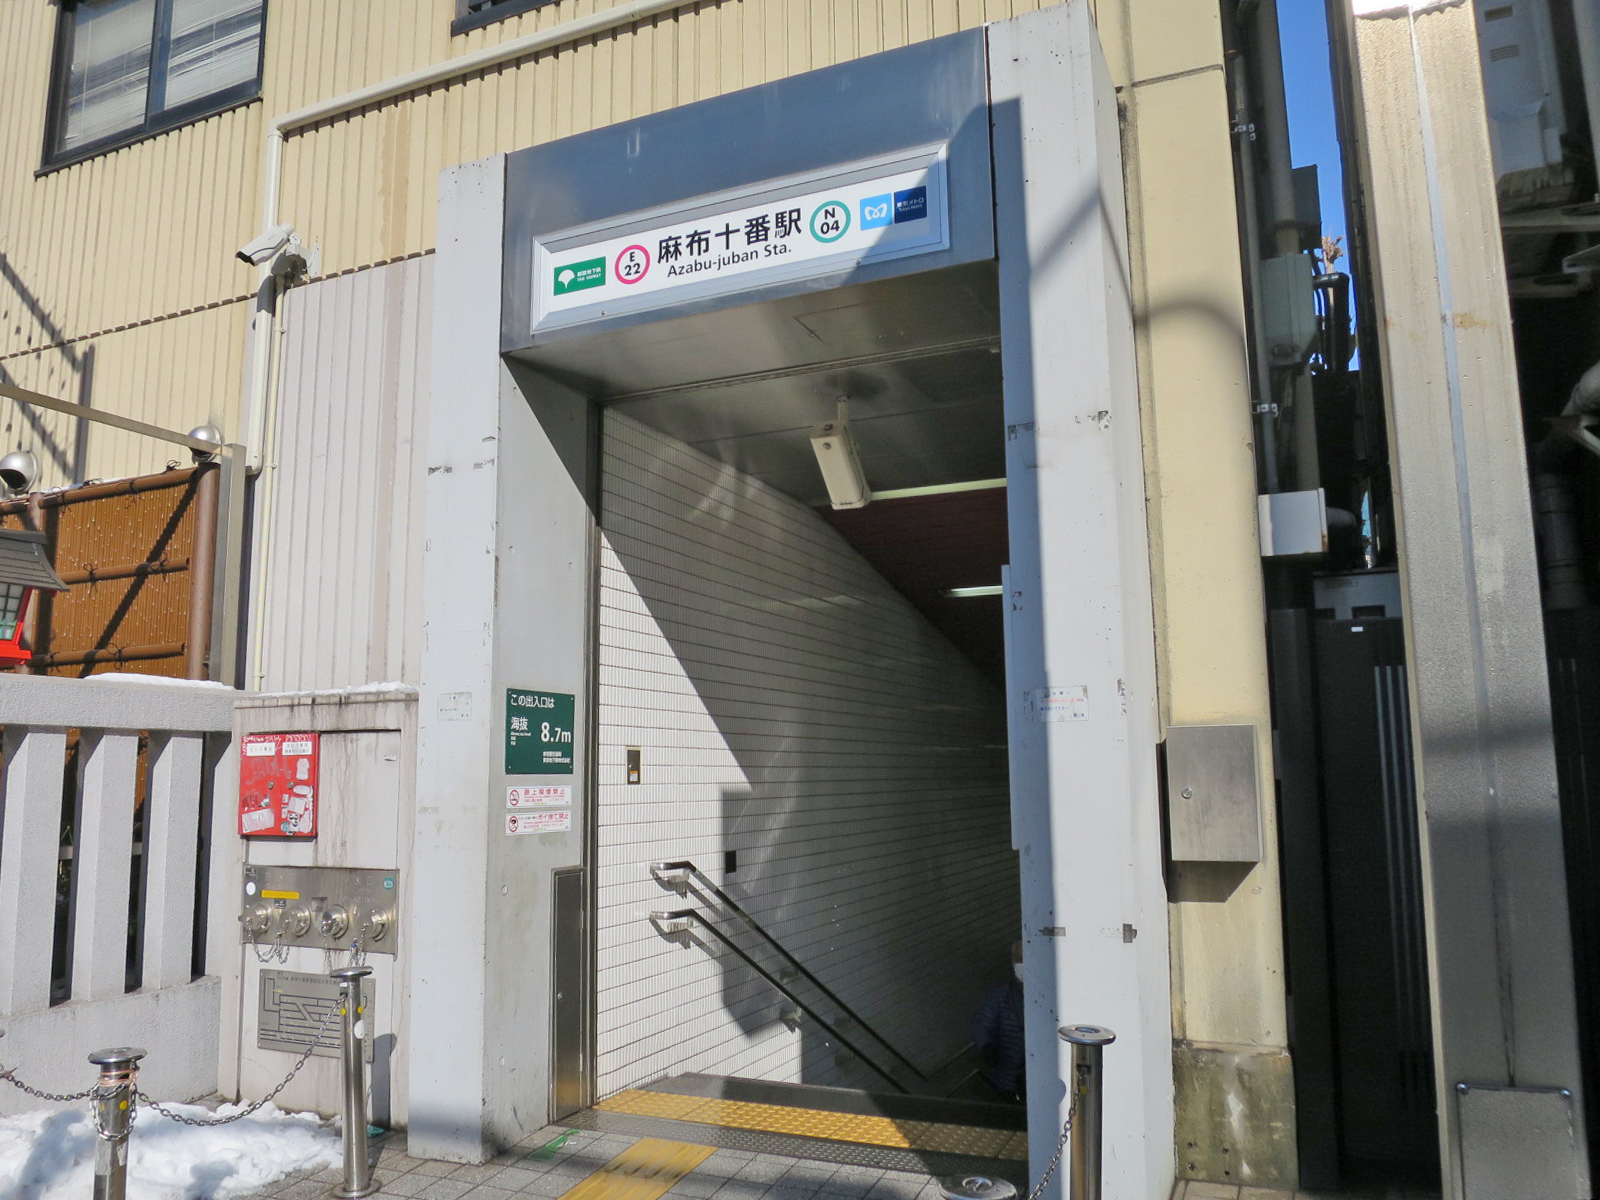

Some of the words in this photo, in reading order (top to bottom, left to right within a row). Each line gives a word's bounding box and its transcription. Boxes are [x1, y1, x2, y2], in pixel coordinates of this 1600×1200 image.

[824, 207, 835, 220] N
[820, 220, 840, 235] 04
[657, 207, 802, 264] 麻布十番駅
[629, 251, 636, 262] E
[667, 249, 758, 277] Azabu-juban
[764, 243, 792, 257] Sta.
[624, 262, 641, 277] 22
[510, 694, 555, 709] この出入口は
[510, 716, 528, 731] 海抜
[541, 721, 571, 743] 8.7m
